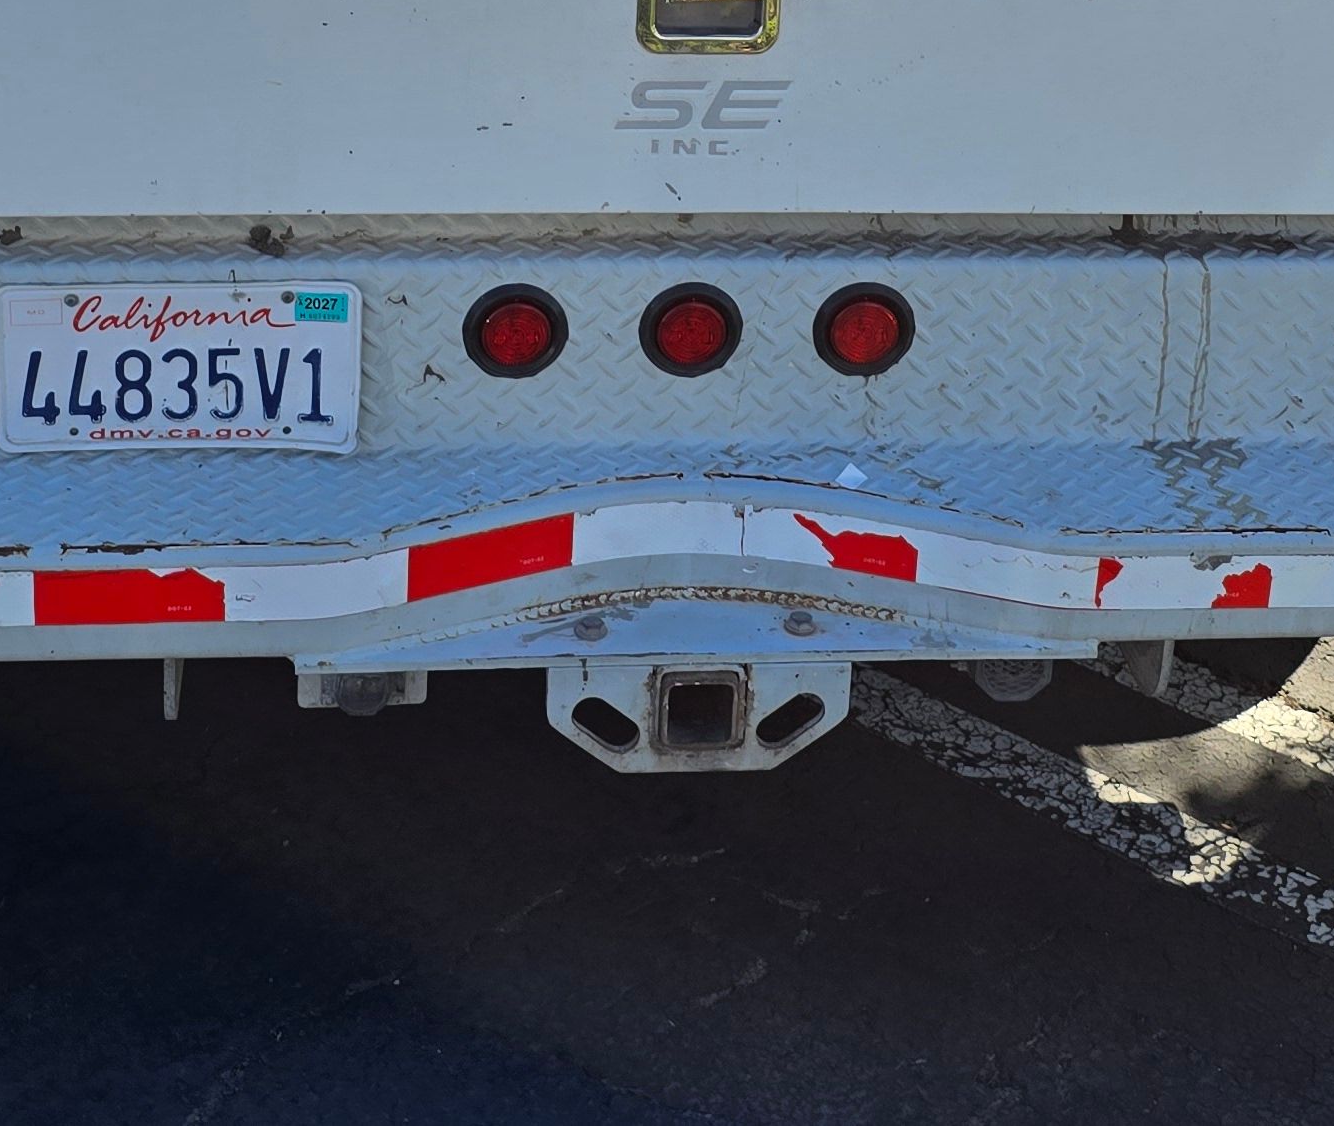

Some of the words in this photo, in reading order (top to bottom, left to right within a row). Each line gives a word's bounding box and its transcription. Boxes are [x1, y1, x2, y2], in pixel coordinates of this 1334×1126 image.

[614, 80, 794, 130] SE
[72, 295, 297, 342] California
[304, 297, 338, 310] 2027
[22, 346, 335, 426] 44835V1
[89, 427, 273, 440] dmv.ca.gov
